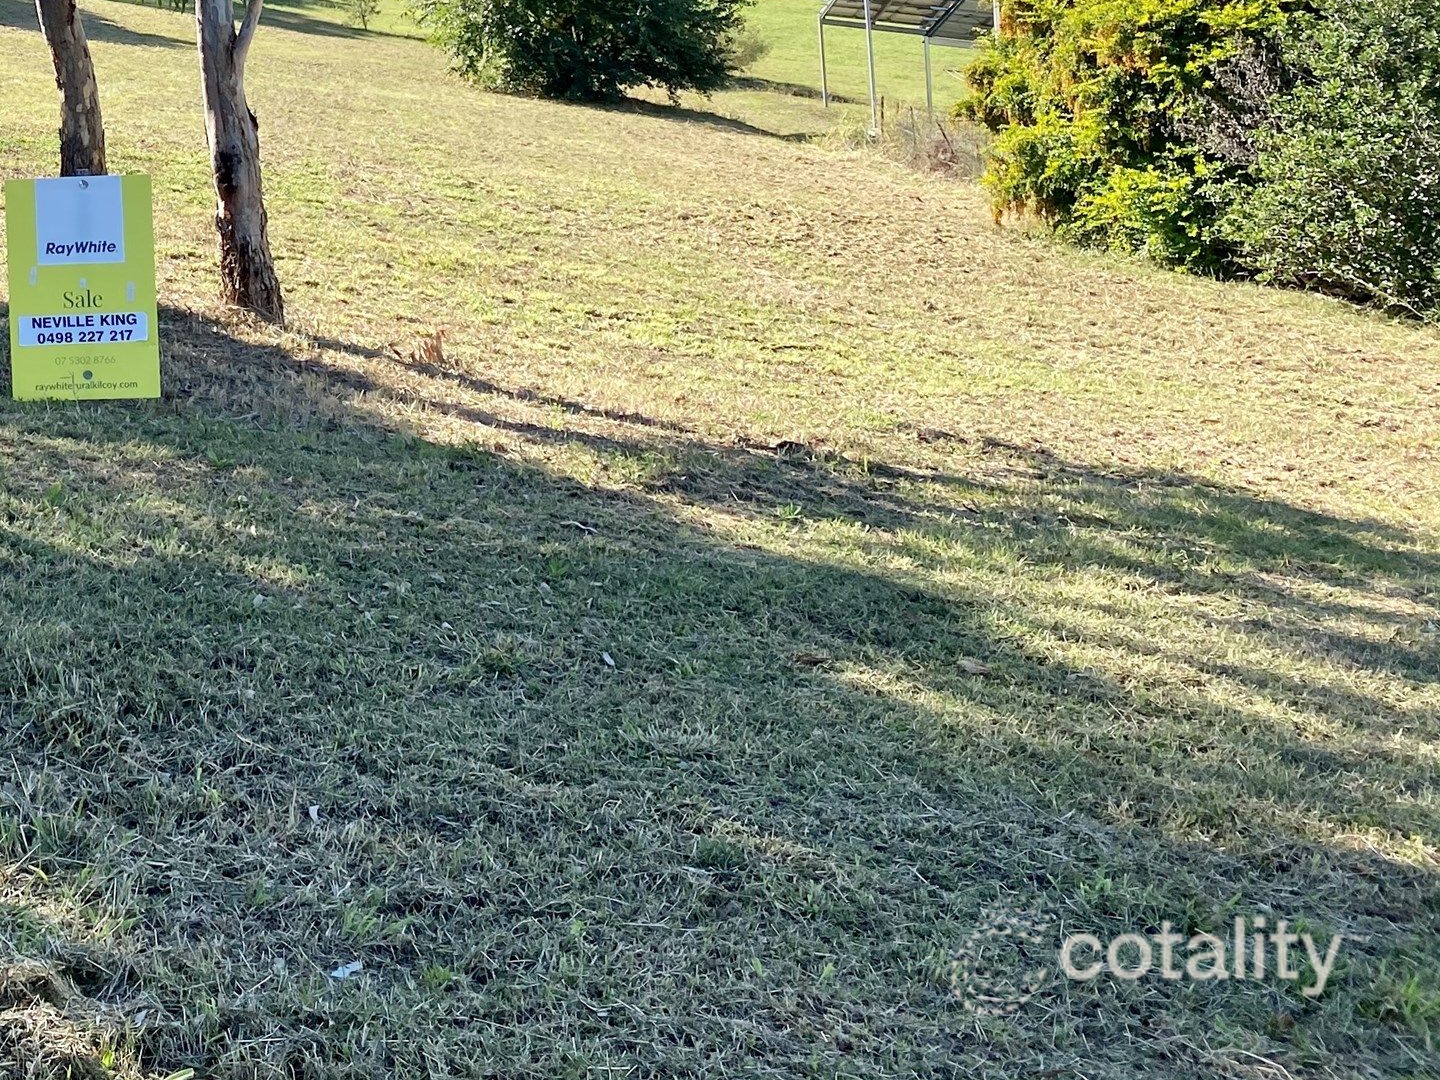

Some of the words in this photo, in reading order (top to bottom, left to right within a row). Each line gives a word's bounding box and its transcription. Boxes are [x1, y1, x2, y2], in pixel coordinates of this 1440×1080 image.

[63, 289, 103, 309] Sale
[31, 315, 94, 329] NEVILLE
[100, 313, 138, 327] KING
[37, 332, 73, 344] 0498
[78, 331, 104, 342] 227
[109, 329, 133, 341] 217
